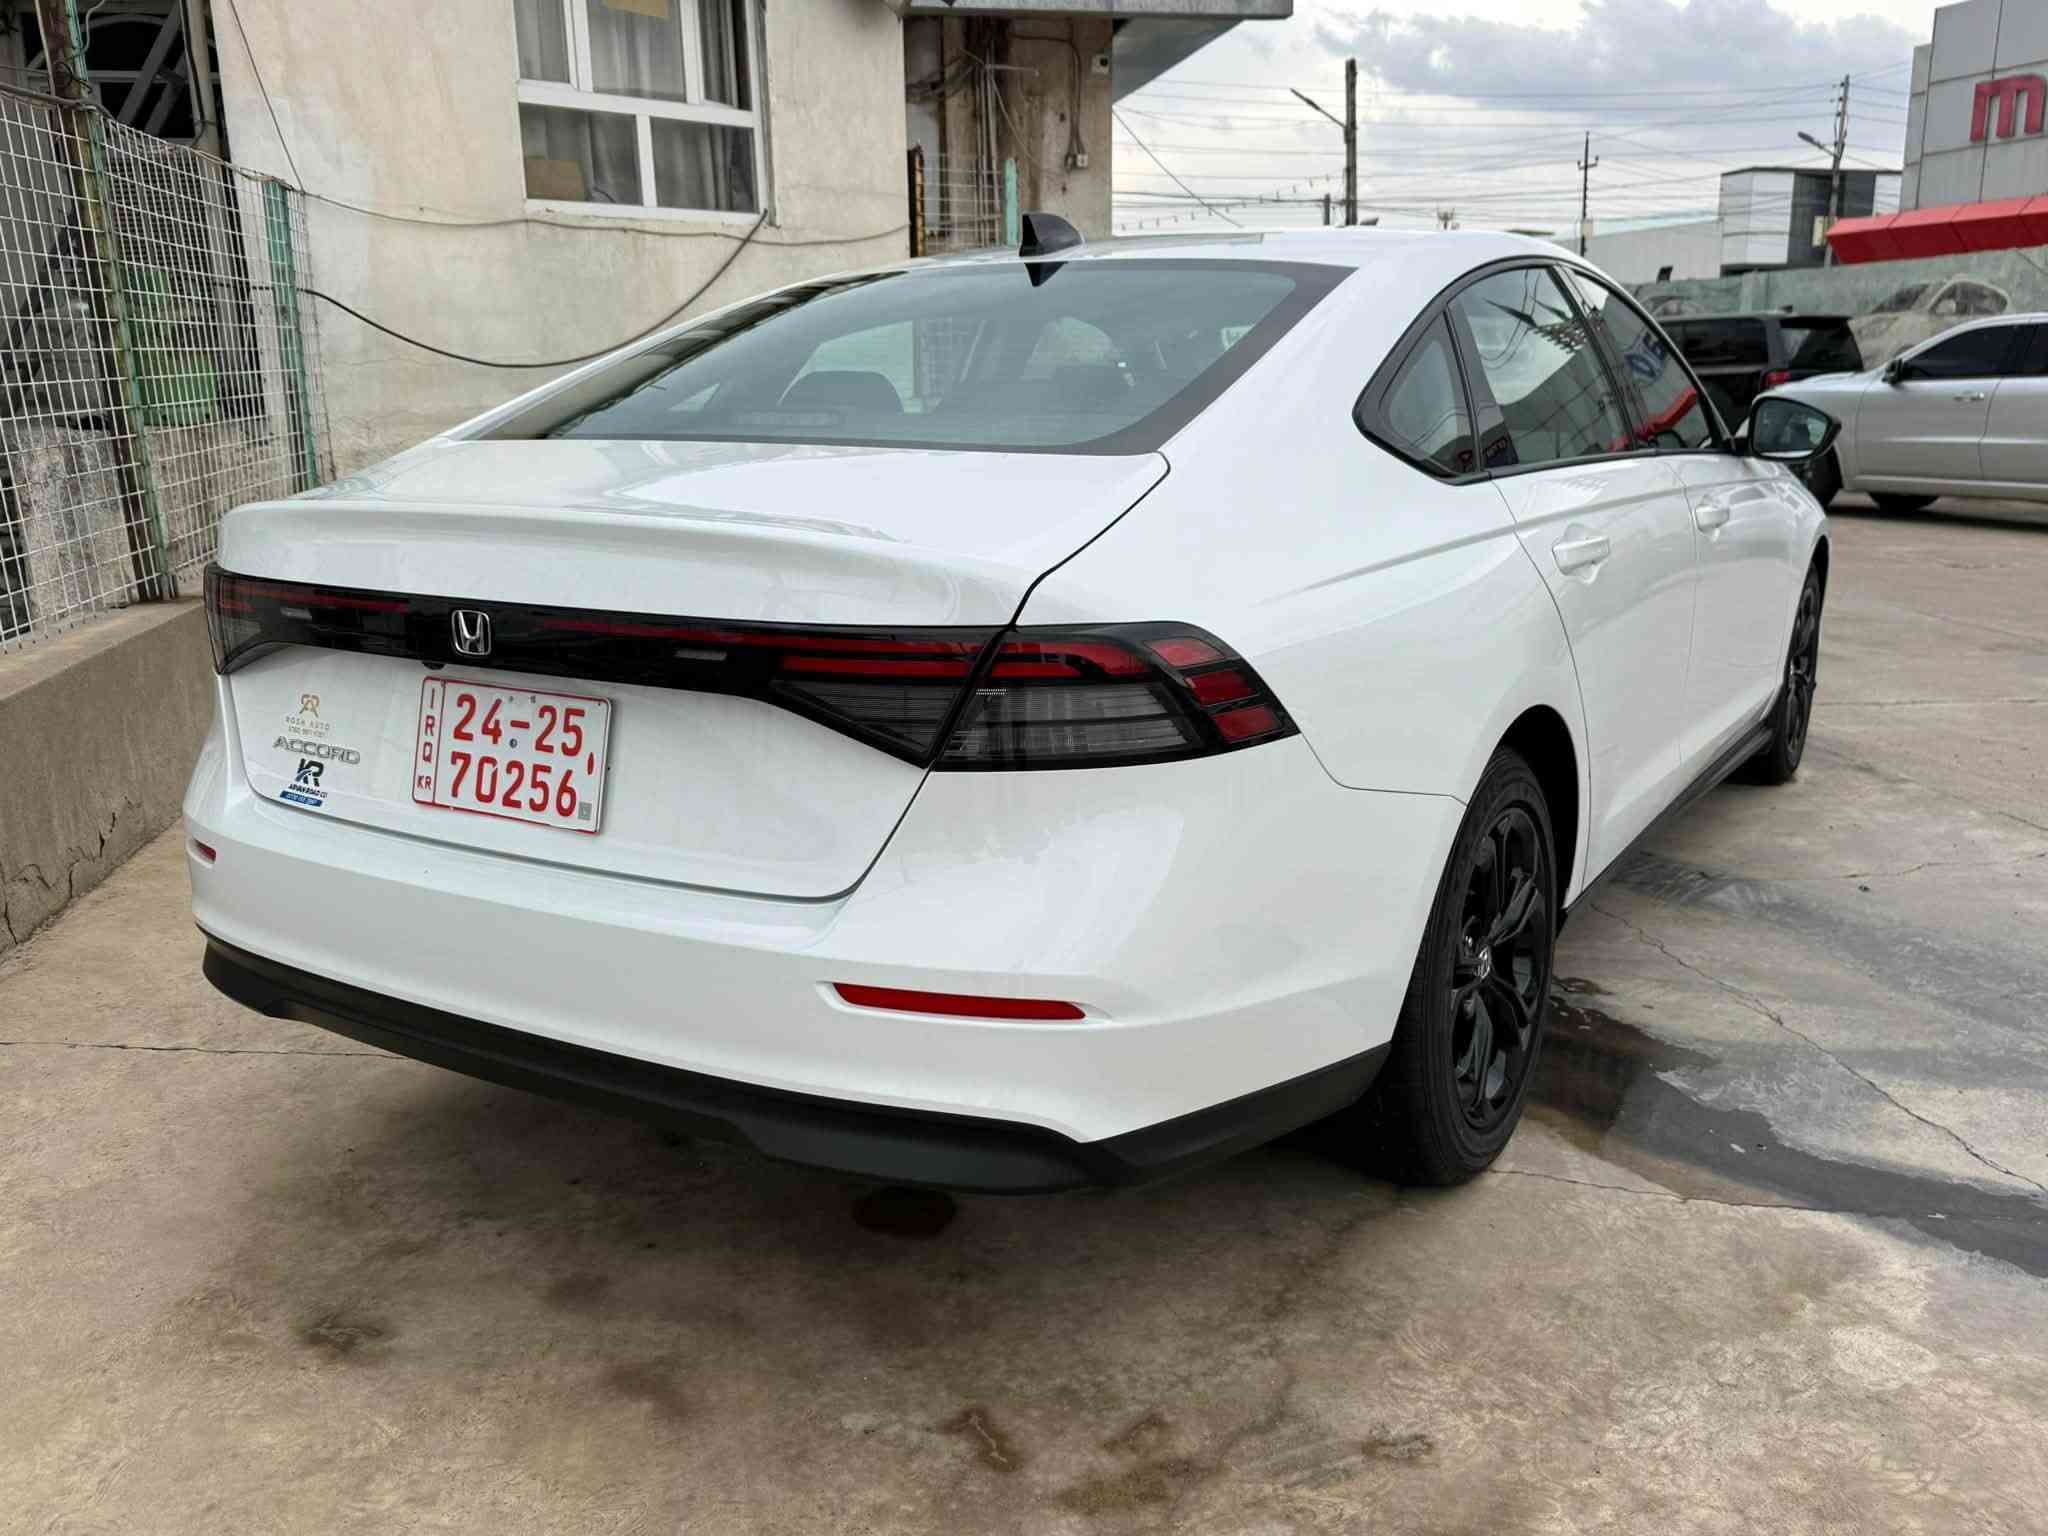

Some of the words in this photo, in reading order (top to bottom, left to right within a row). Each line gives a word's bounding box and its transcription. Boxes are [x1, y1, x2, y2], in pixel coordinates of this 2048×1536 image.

[453, 693, 585, 757] 24-25
[272, 735, 361, 765] ACCORD
[416, 775, 432, 790] KR
[450, 750, 577, 818] 70256
